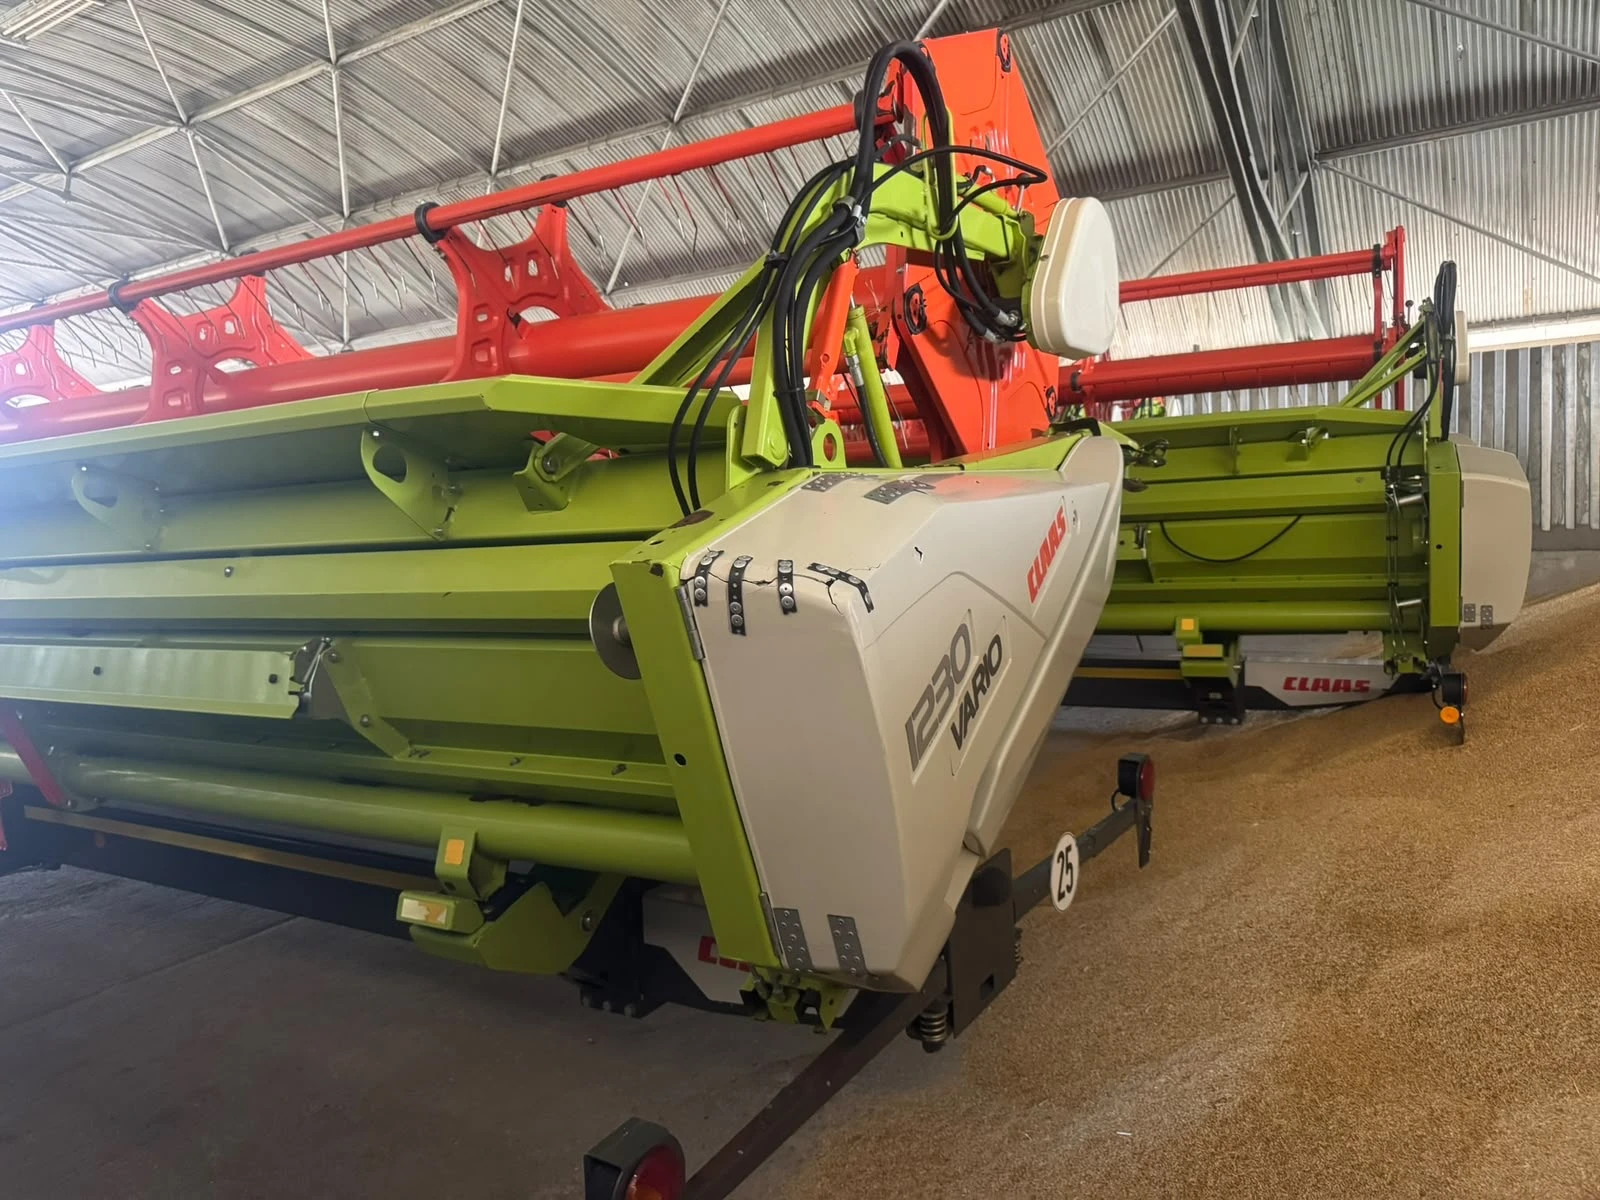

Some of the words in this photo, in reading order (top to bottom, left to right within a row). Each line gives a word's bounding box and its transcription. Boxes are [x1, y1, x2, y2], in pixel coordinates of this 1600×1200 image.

[1026, 506, 1068, 604] CLAAS
[904, 623, 971, 772] 1230
[950, 634, 1002, 750] VARIO
[1283, 676, 1370, 693] CLAAS
[1057, 844, 1074, 903] 25
